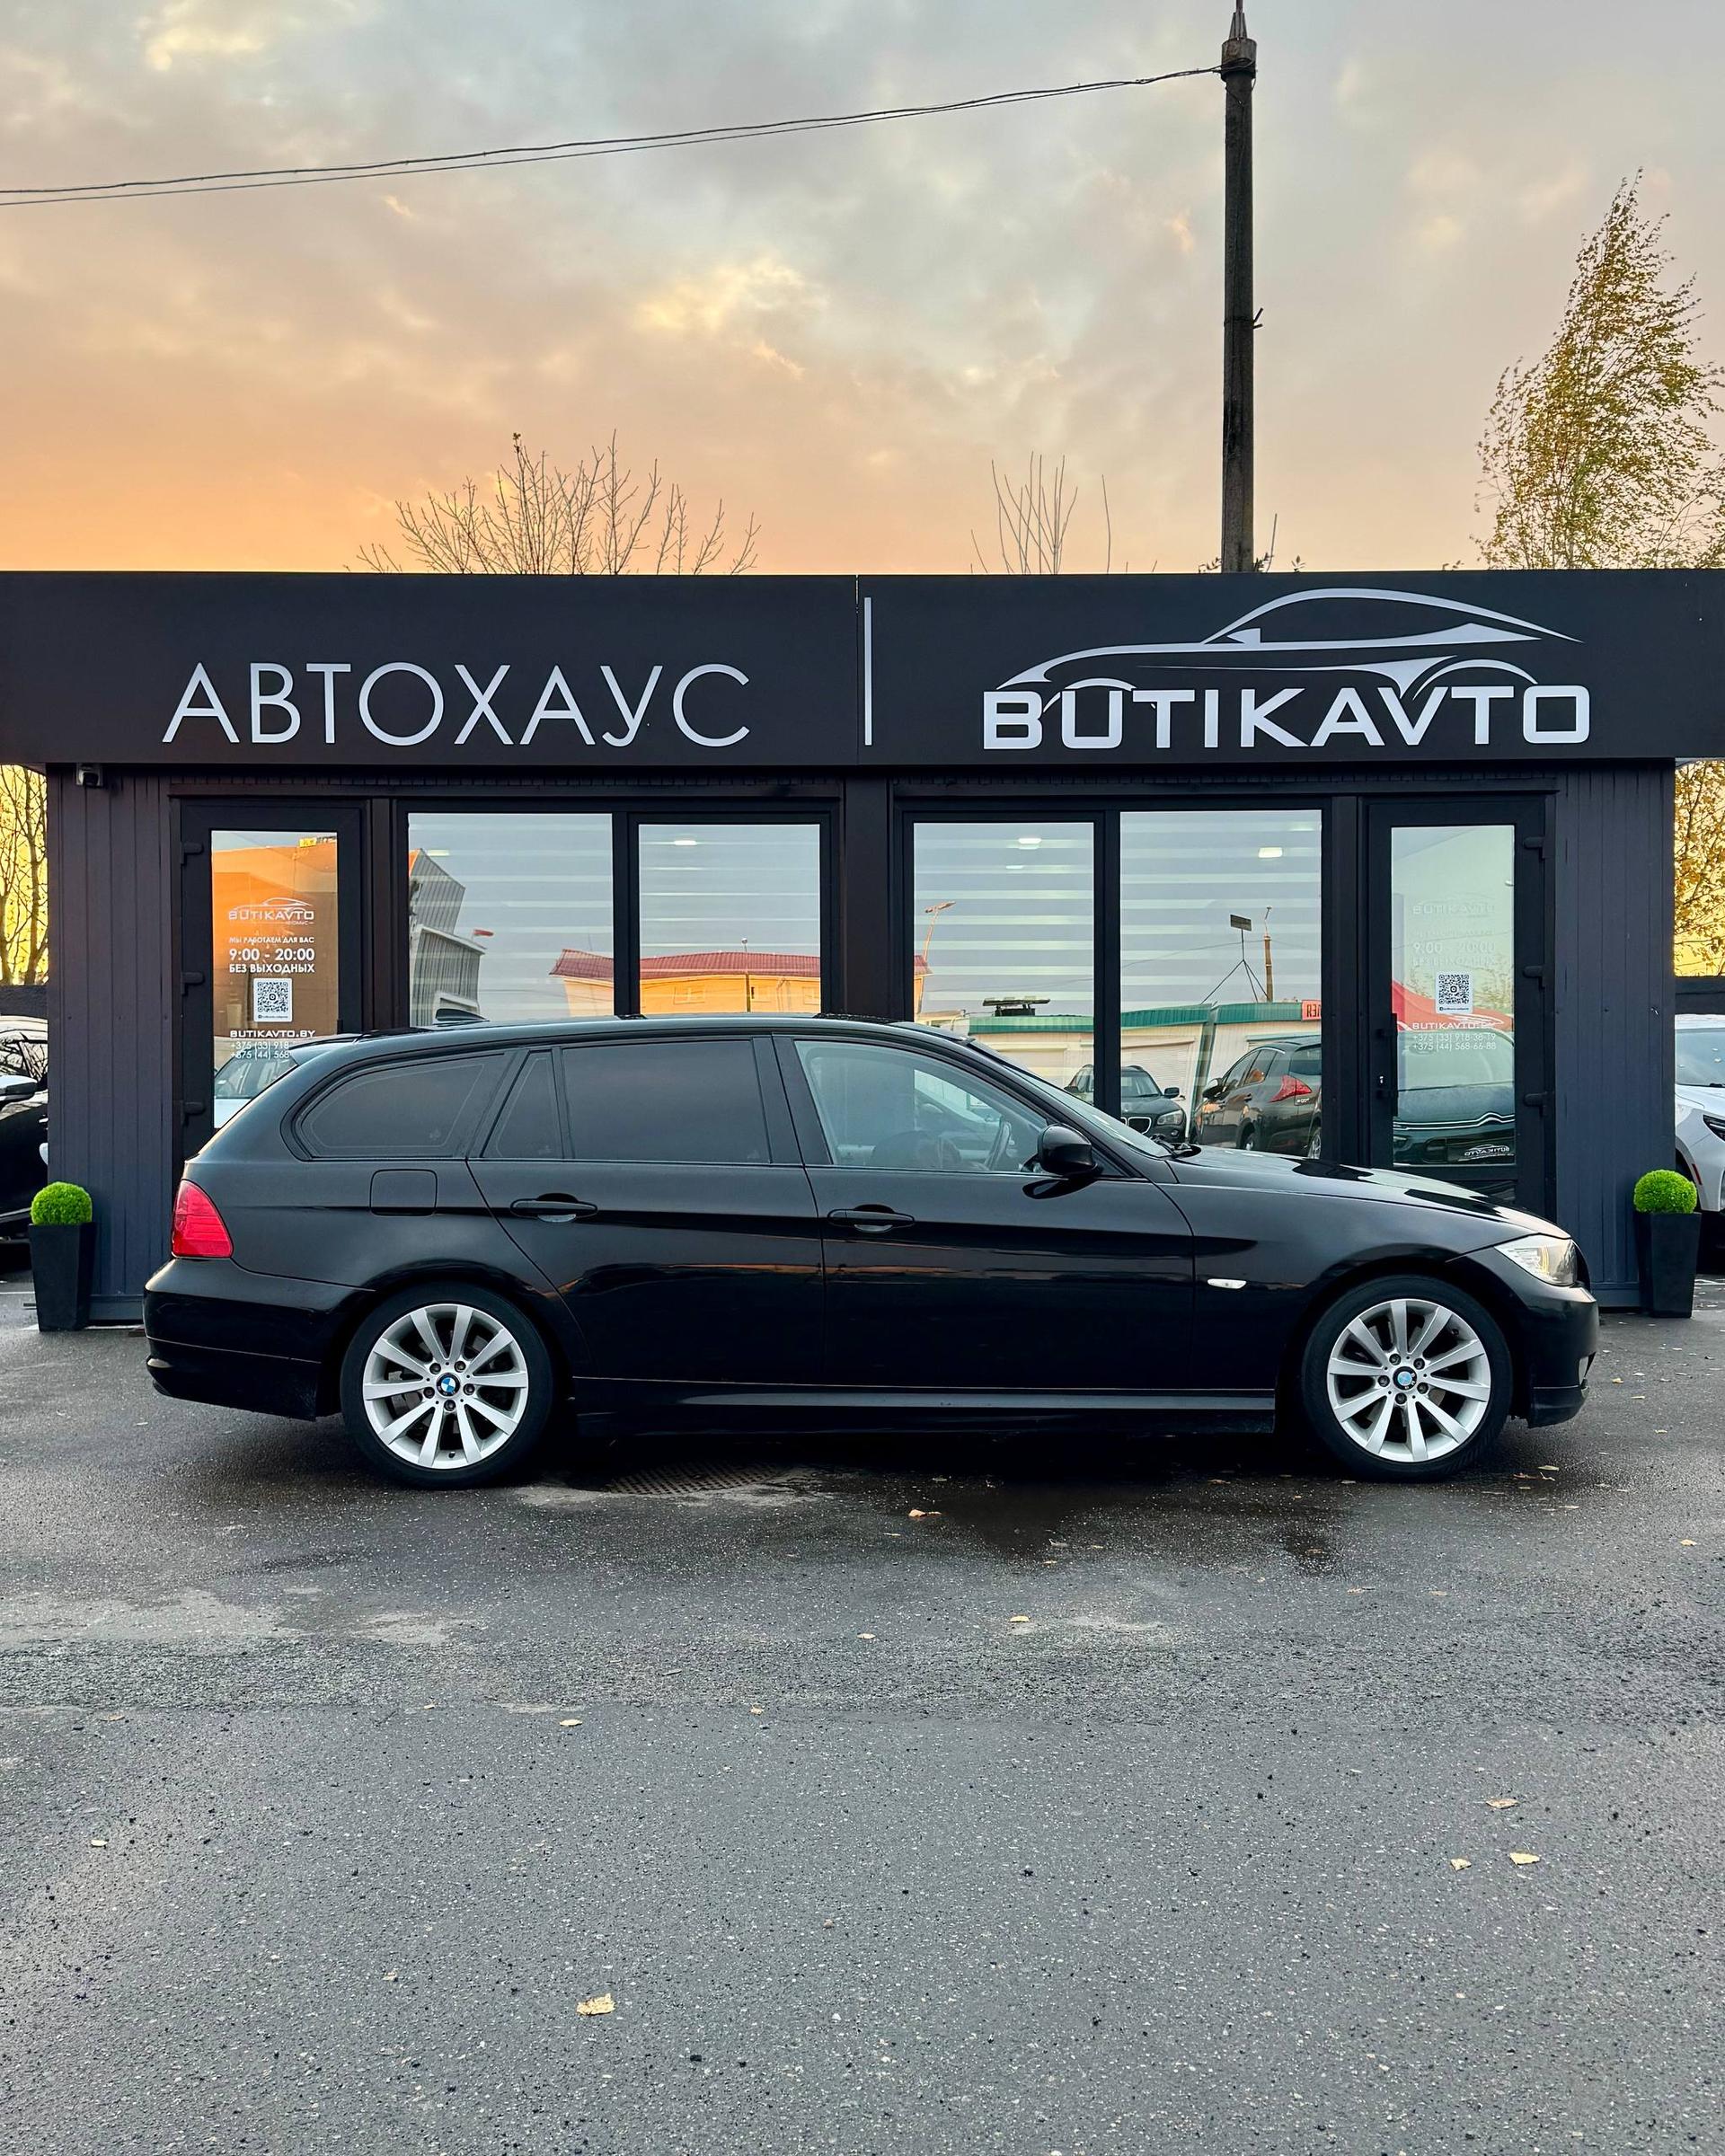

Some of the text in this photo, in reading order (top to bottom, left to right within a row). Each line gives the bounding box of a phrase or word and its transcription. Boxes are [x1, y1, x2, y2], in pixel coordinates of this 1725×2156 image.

[162, 662, 750, 747] АВТОХАУС
[983, 685, 1590, 750] BUTIKAVTO
[228, 910, 314, 920] BUTIKAVTO
[229, 948, 260, 961] 9:00
[275, 948, 315, 961] 20:00
[229, 964, 314, 974] БЕЗ ВЫХОДНЫХ
[230, 1029, 315, 1038] BUTIKAVTO.BY
